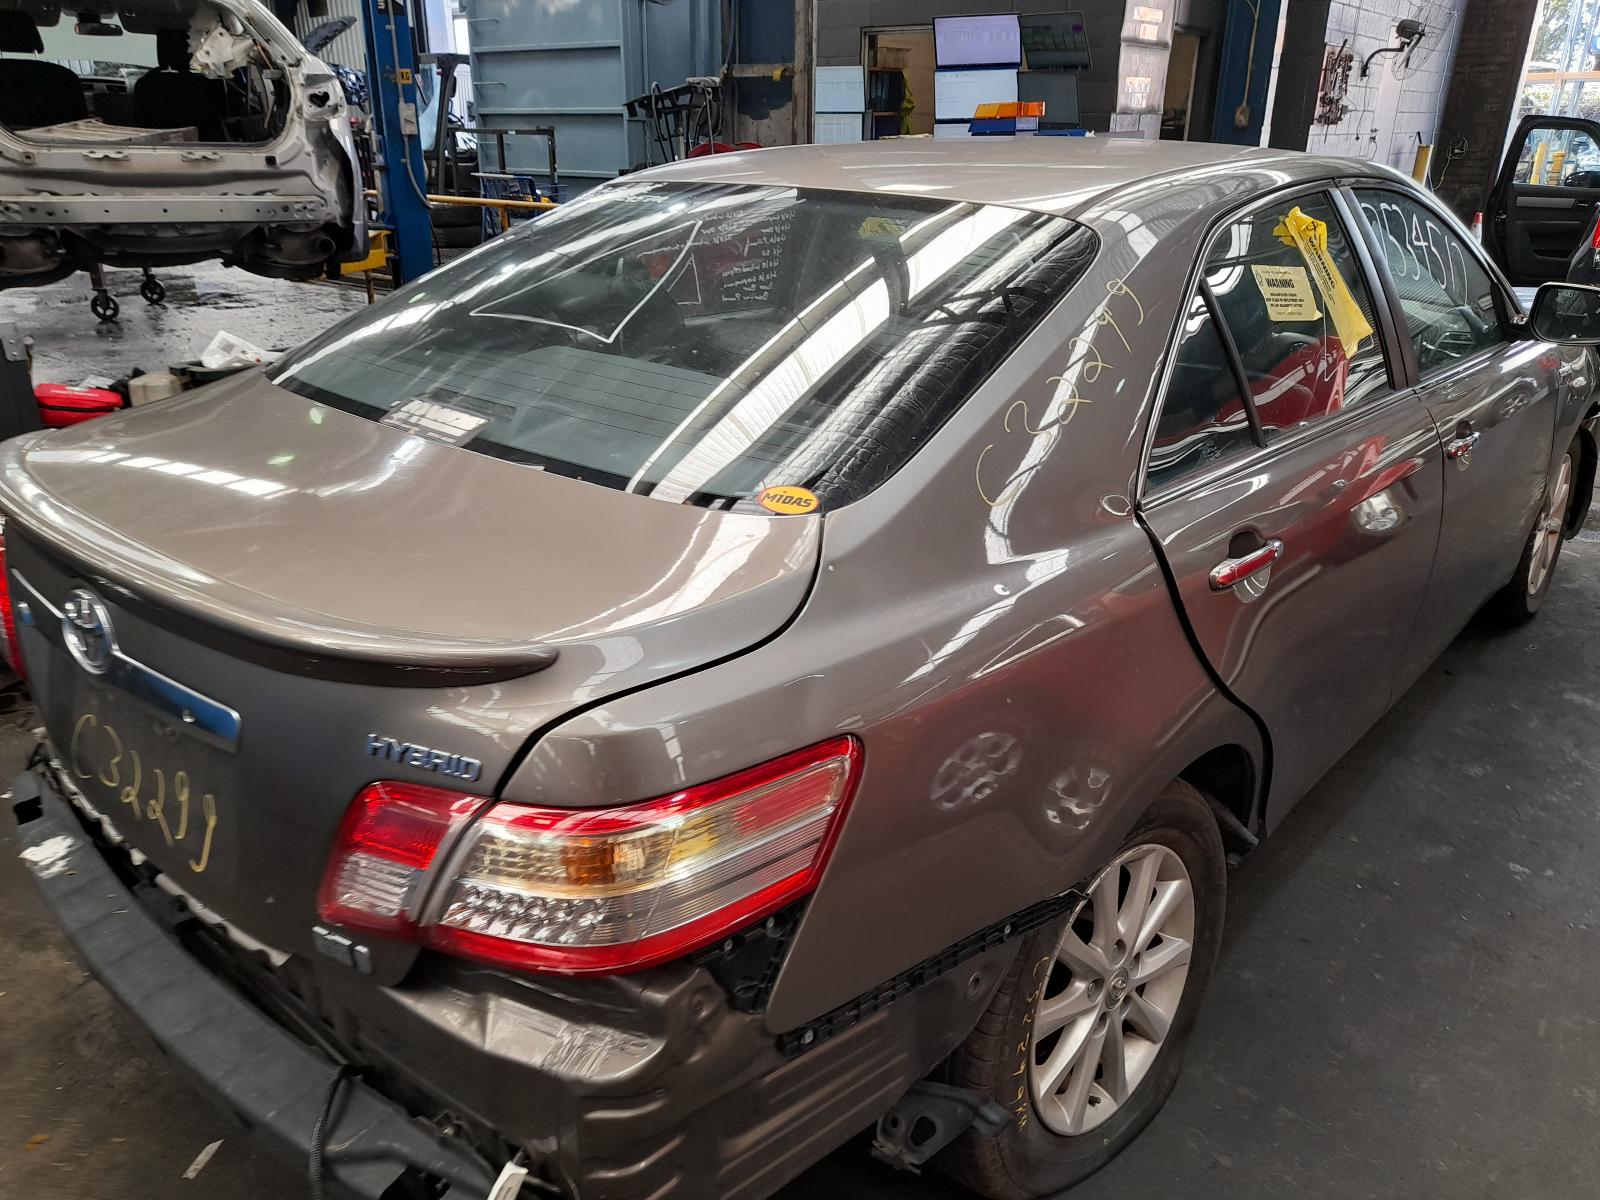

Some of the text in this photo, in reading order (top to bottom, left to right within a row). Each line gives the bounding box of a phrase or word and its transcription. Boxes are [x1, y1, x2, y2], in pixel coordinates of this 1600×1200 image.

[1264, 277, 1295, 289] WARNING
[1308, 236, 1337, 290] WARNING
[366, 732, 482, 782] HYBRID
